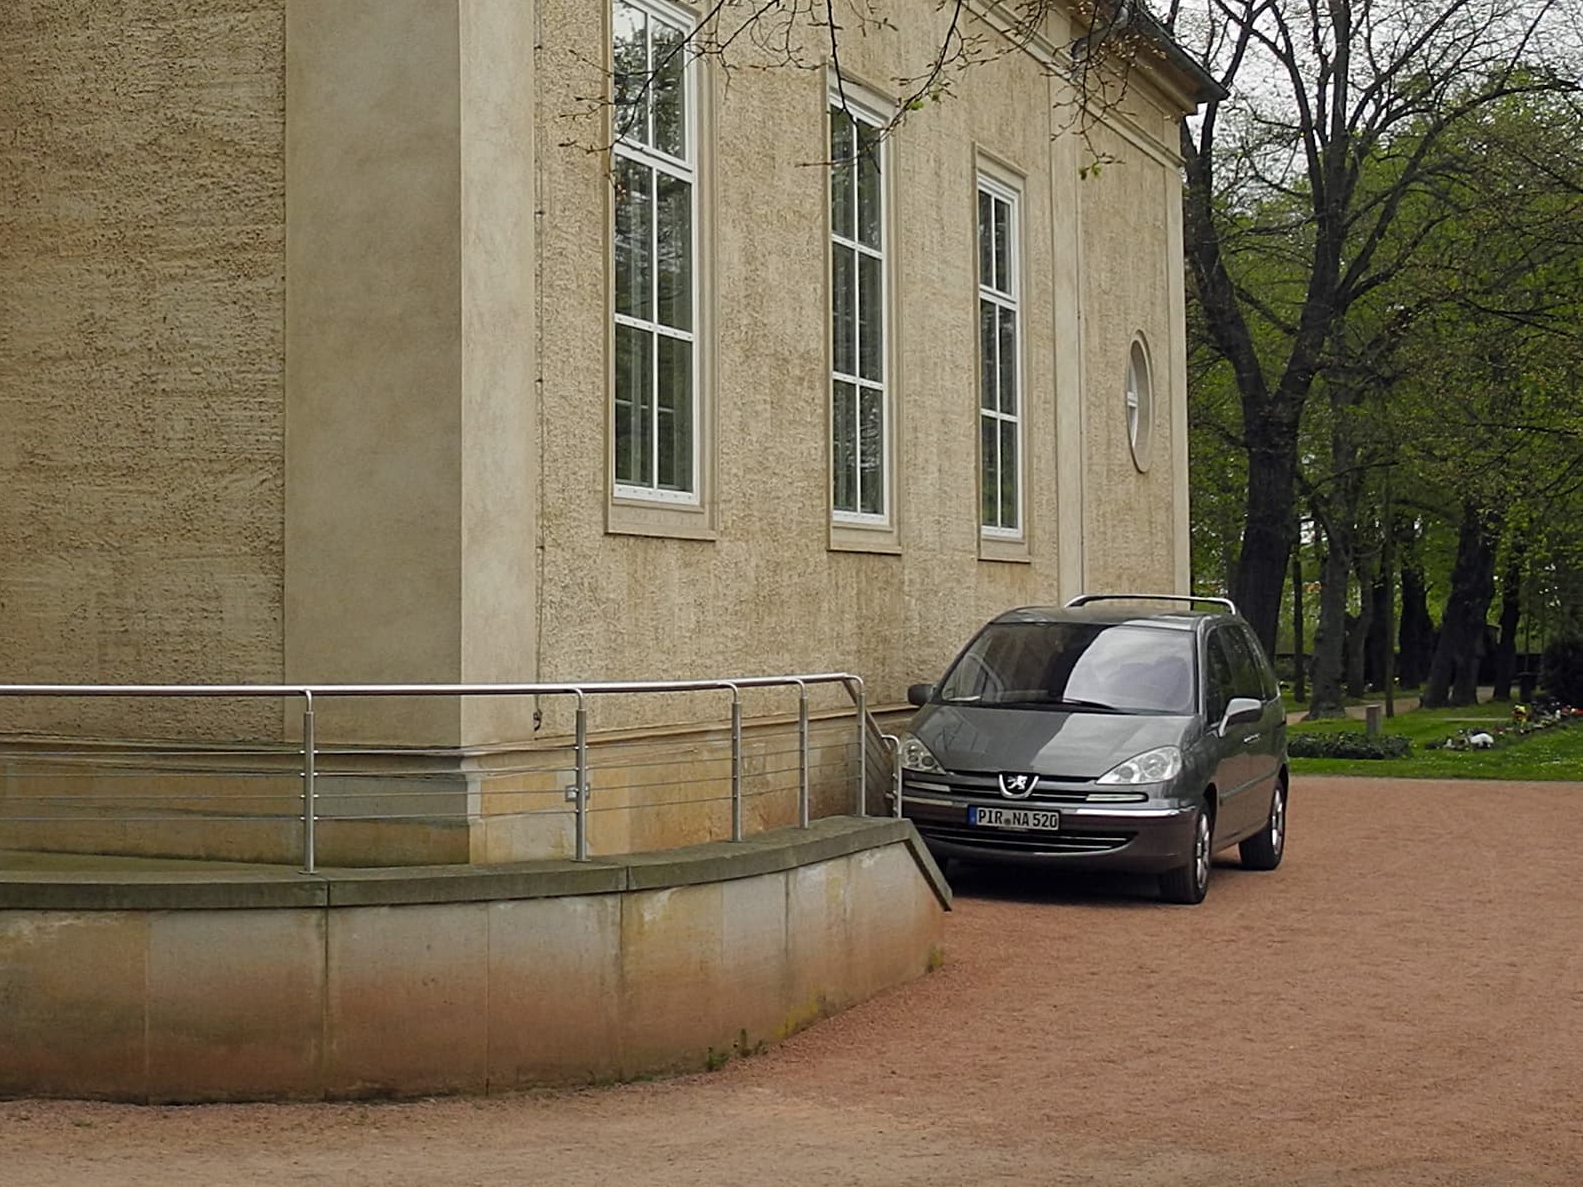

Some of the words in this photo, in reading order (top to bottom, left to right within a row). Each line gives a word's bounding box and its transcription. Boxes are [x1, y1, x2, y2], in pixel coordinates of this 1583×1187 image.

[978, 809, 1003, 824] PIR
[1012, 812, 1030, 826] NA
[1033, 813, 1058, 828] 520
